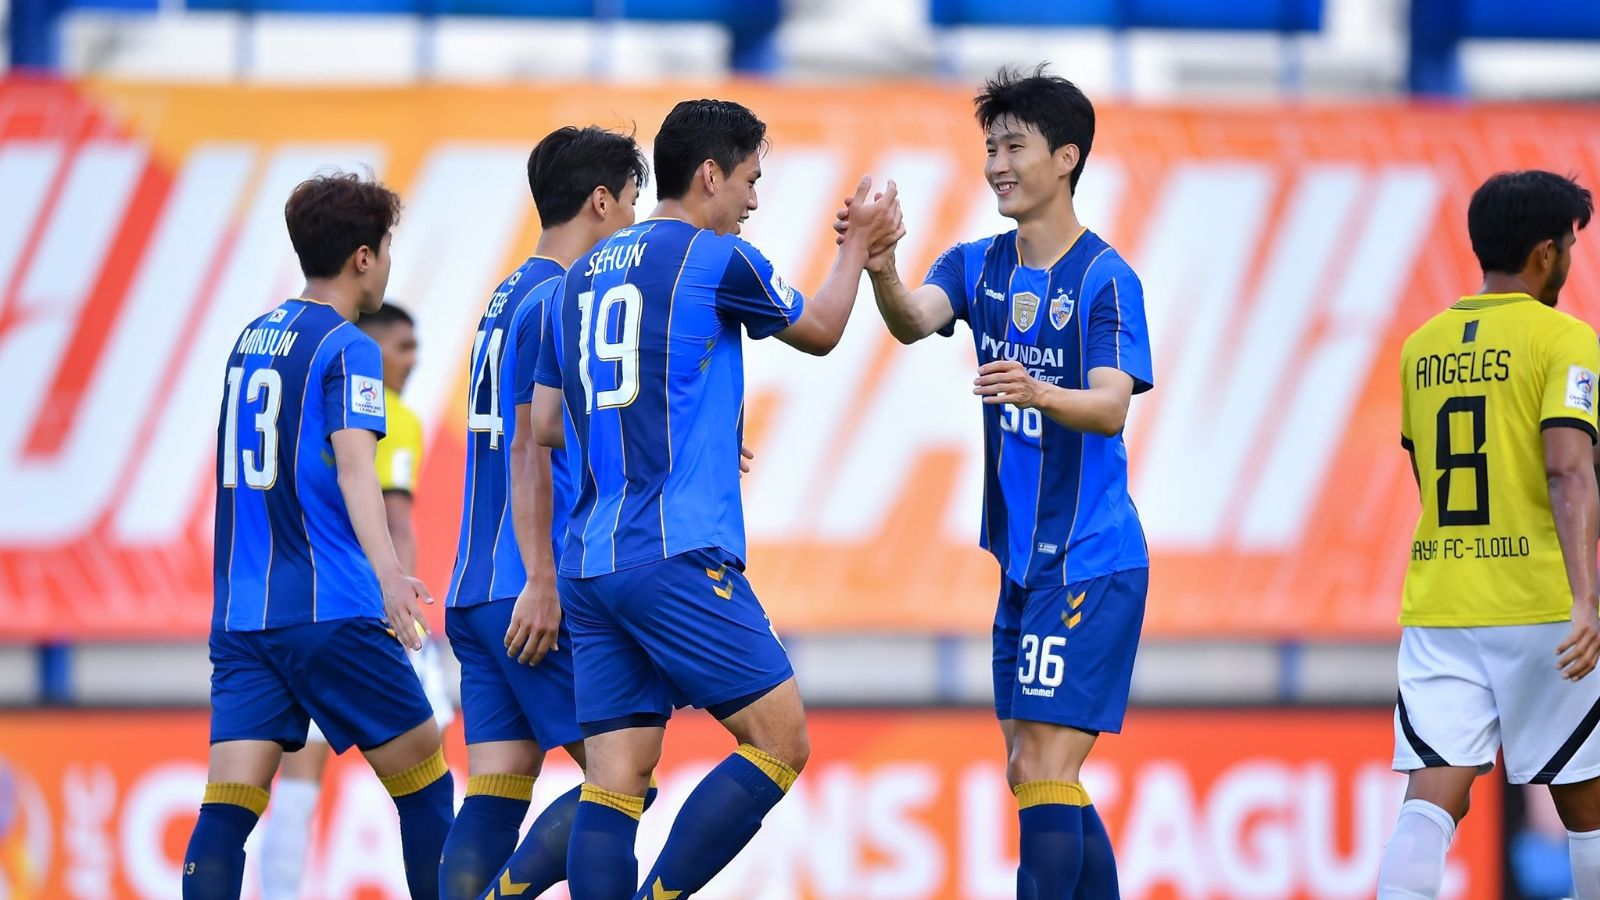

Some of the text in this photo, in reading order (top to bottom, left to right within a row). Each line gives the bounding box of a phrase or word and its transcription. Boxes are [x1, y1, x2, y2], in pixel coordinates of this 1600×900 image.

[584, 243, 649, 277] SEHUN
[237, 328, 299, 357] MINJUN
[578, 283, 643, 415] 19
[1416, 349, 1511, 390] ANGELES
[223, 367, 283, 491] 13
[1436, 395, 1490, 528] 8
[1444, 536, 1530, 559] FC-ILOILO
[1018, 634, 1067, 687] 36
[1022, 685, 1055, 698] hummel
